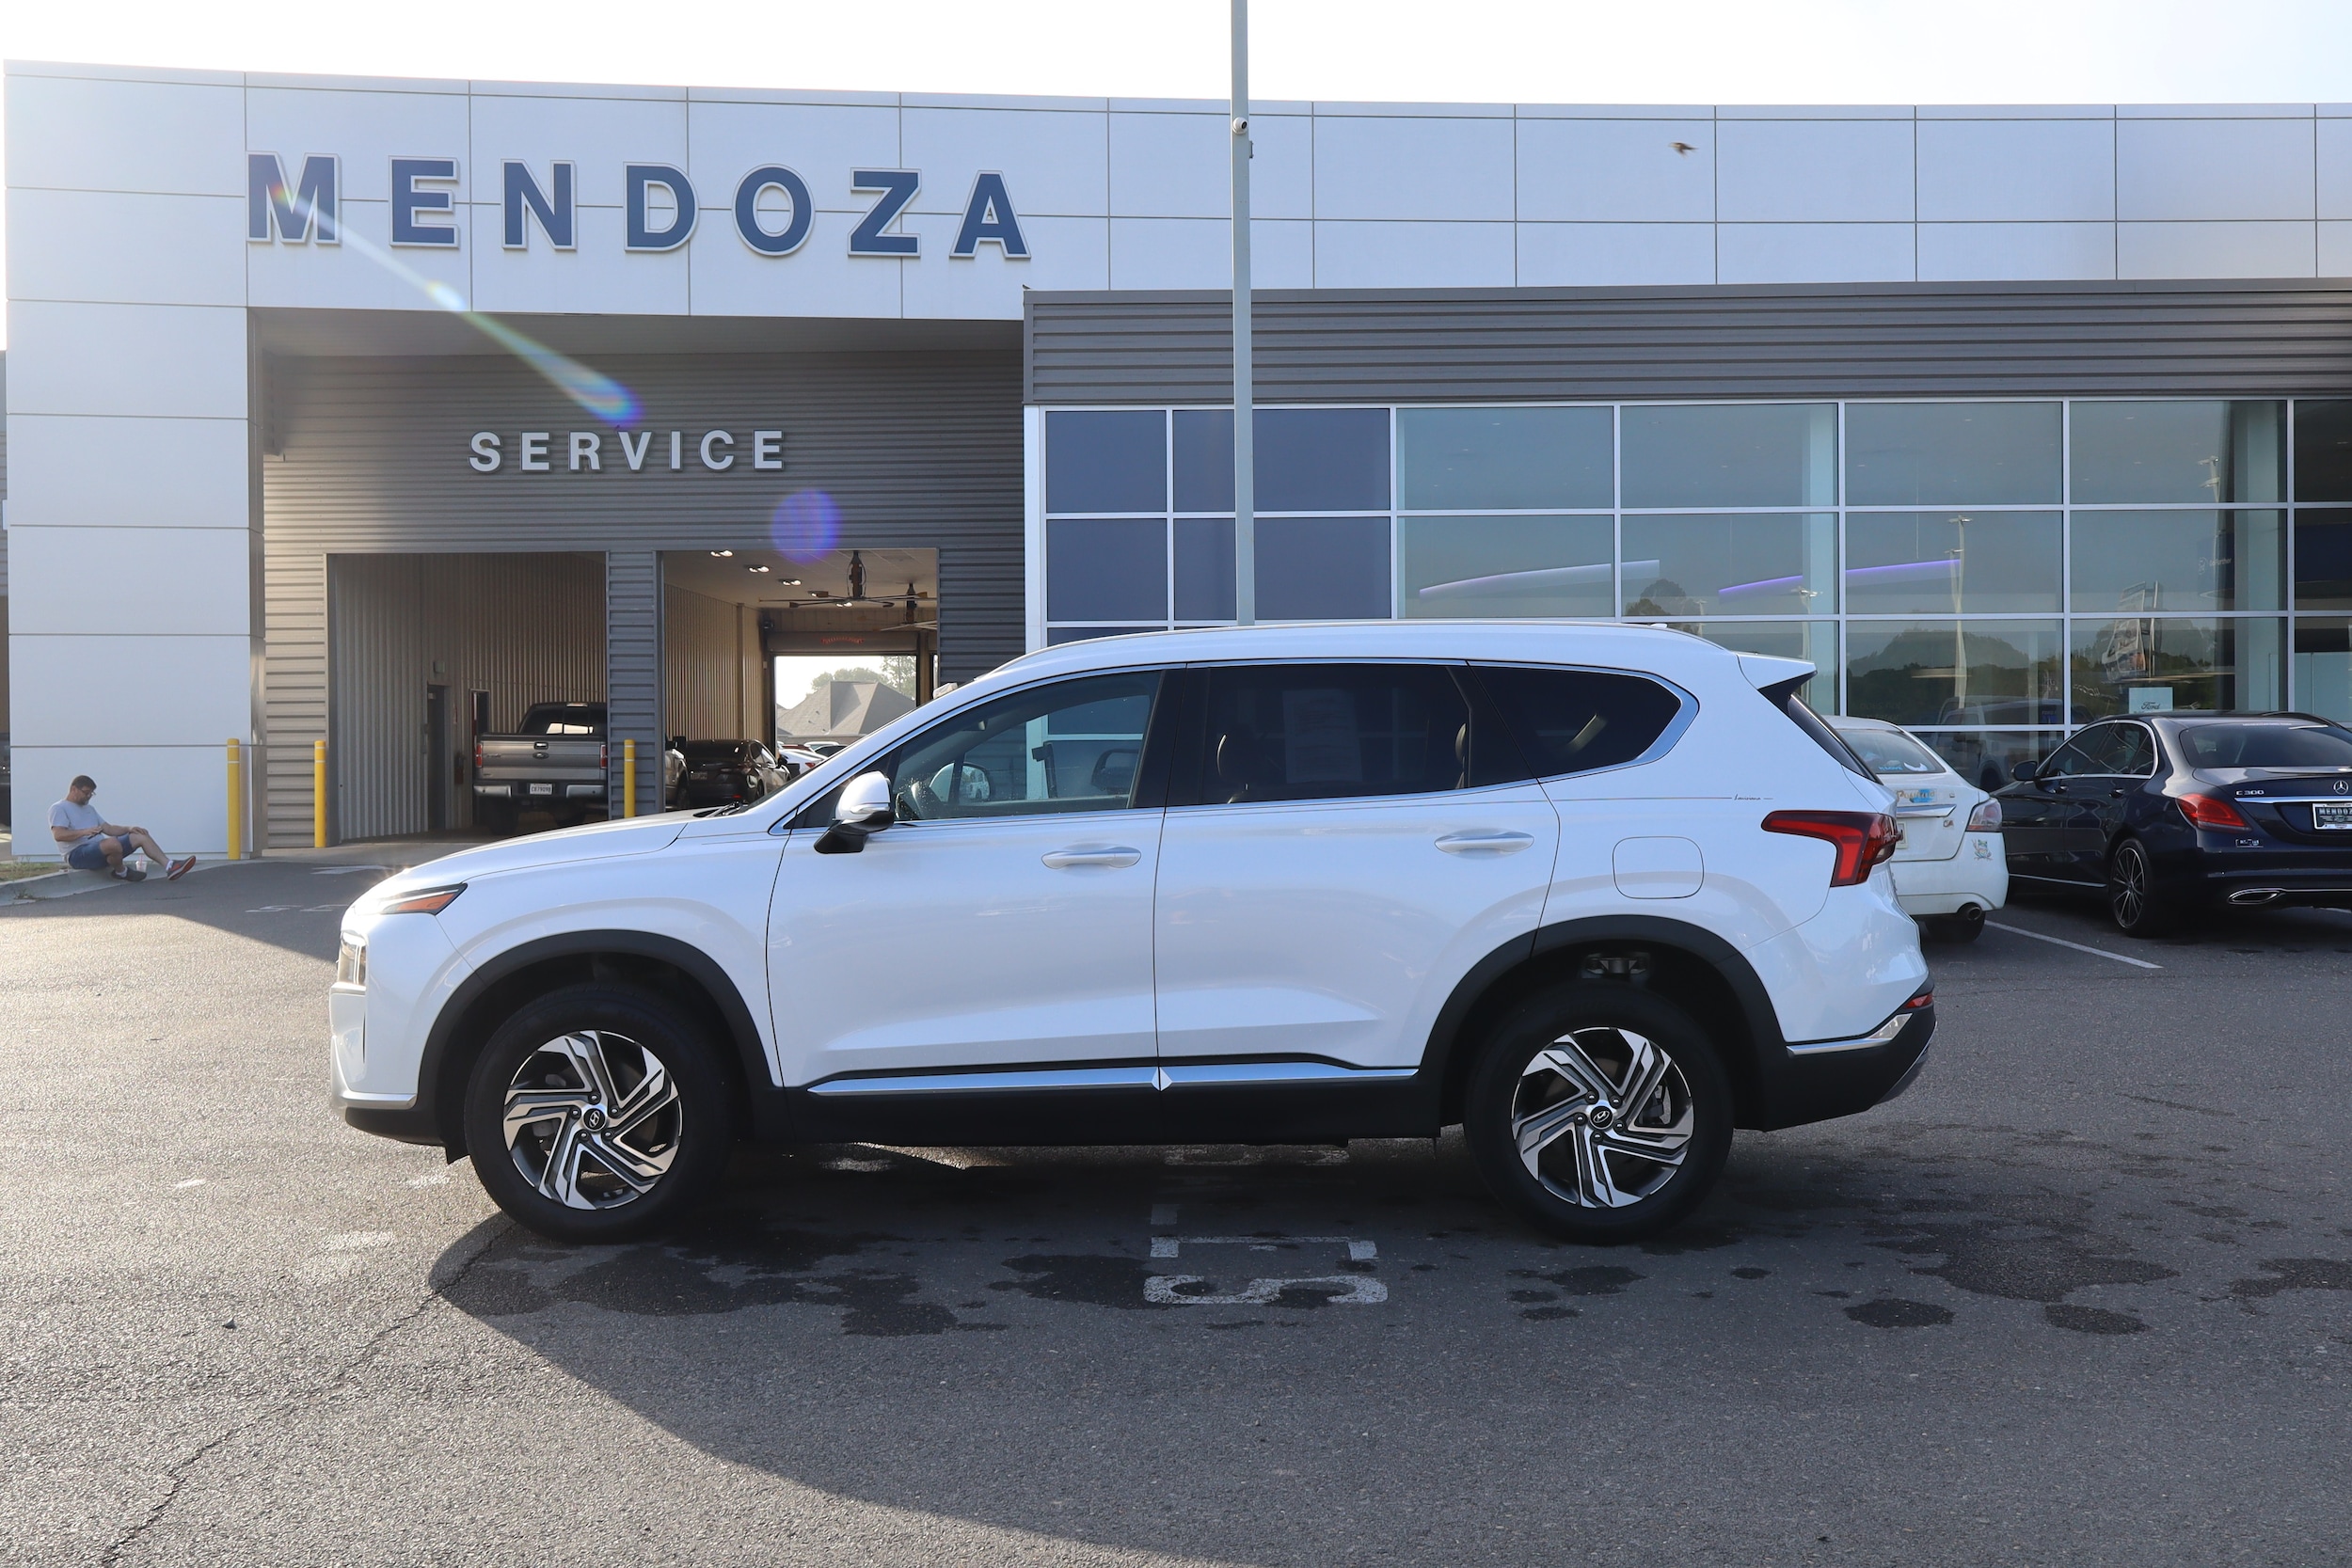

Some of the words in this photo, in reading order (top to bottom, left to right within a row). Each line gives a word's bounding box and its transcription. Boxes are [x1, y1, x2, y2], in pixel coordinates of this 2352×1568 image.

[246, 150, 1031, 259] MENDOZA
[468, 429, 785, 472] SERVICE
[2140, 701, 2161, 710] Ford
